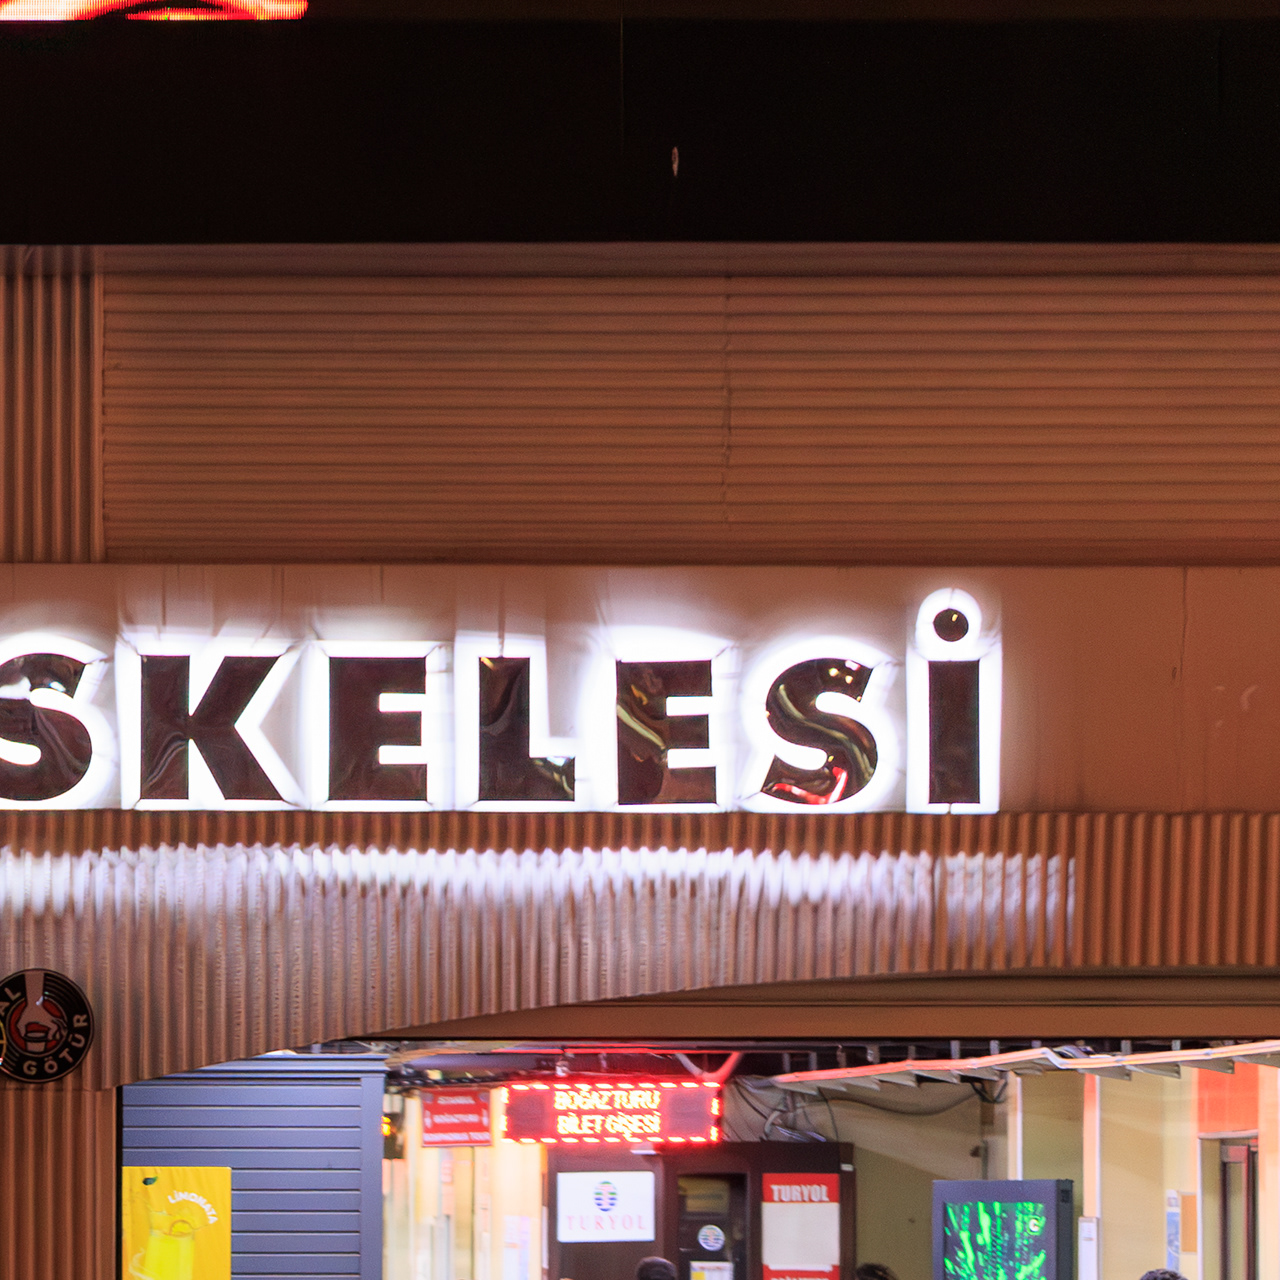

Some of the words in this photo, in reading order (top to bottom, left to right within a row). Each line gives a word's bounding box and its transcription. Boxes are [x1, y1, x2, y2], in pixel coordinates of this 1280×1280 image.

[22, 1013, 89, 1077] GÖTÜR
[771, 1184, 830, 1202] TURYOL
[566, 1214, 649, 1231] TURYOL
